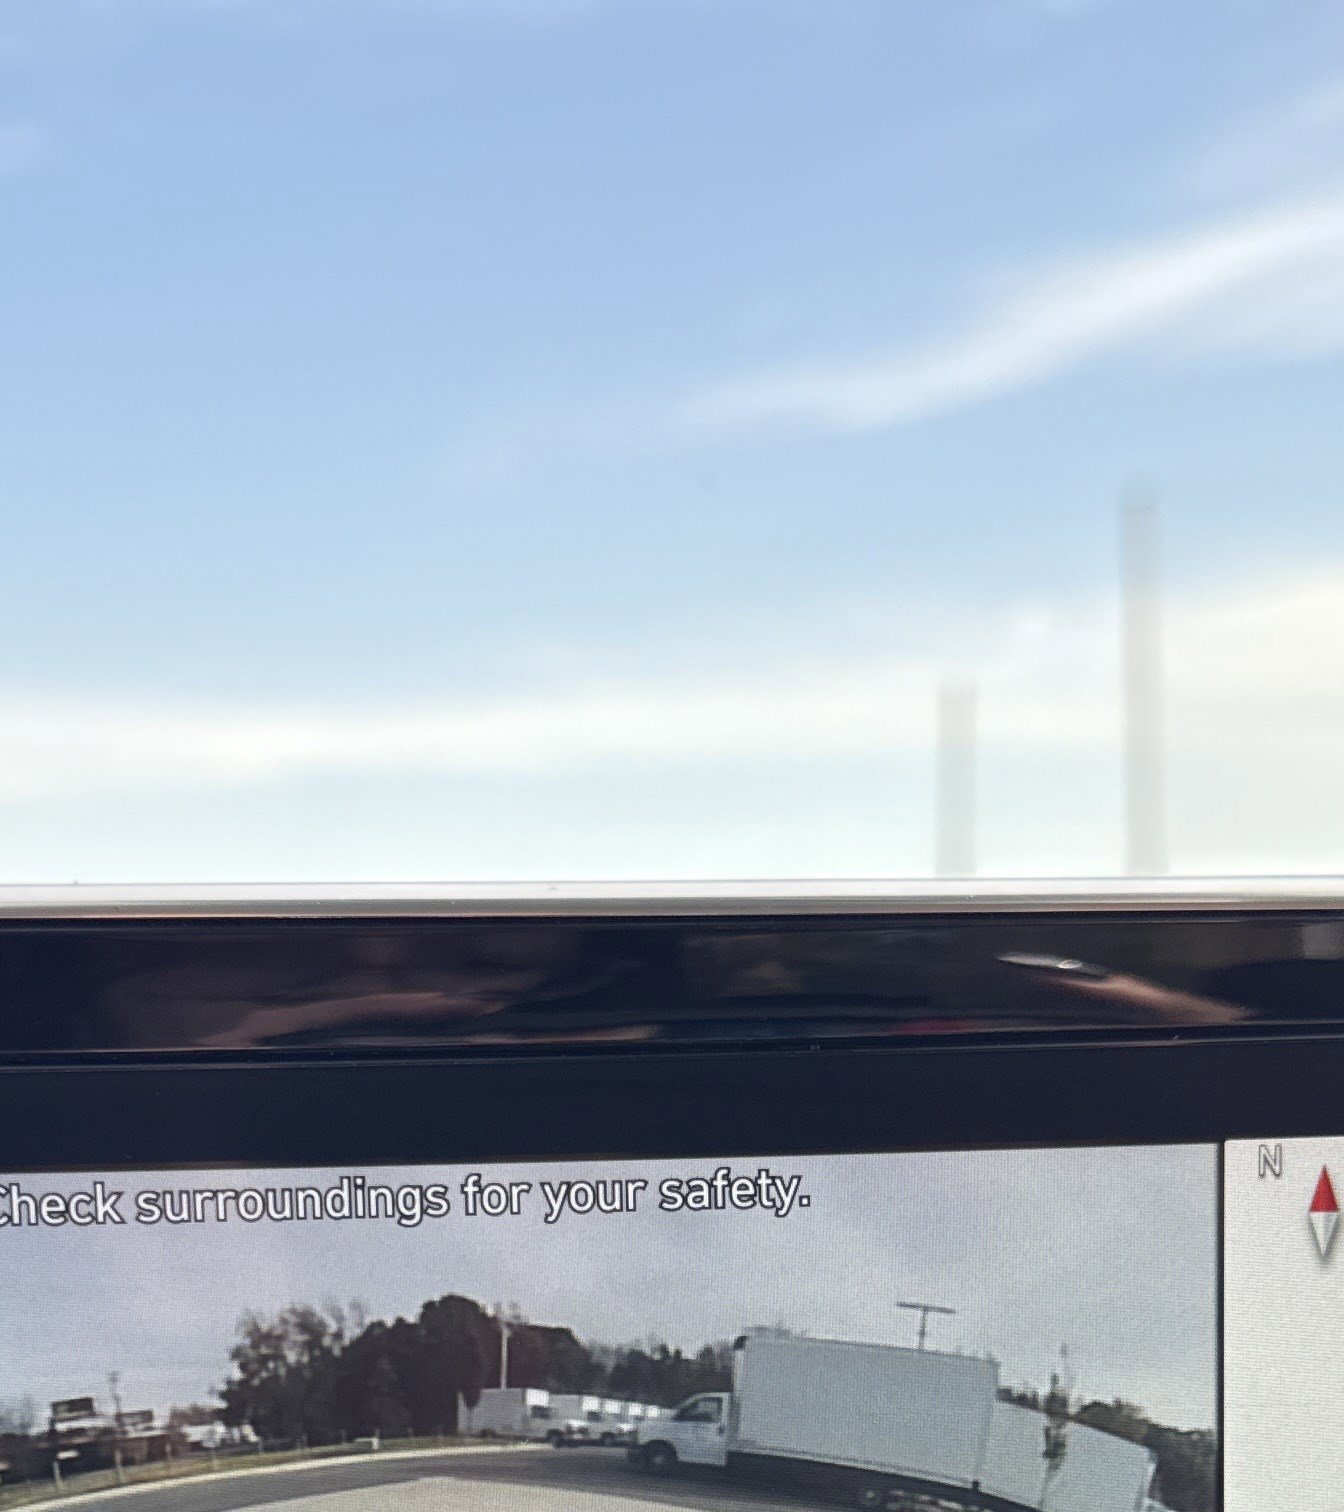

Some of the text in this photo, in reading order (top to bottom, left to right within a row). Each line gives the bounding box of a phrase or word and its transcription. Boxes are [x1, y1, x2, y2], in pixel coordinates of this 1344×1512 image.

[1258, 1143, 1283, 1179] N
[135, 1176, 450, 1226] surroundings
[461, 1173, 533, 1217] for
[542, 1179, 646, 1223] your
[660, 1167, 812, 1219] safety.
